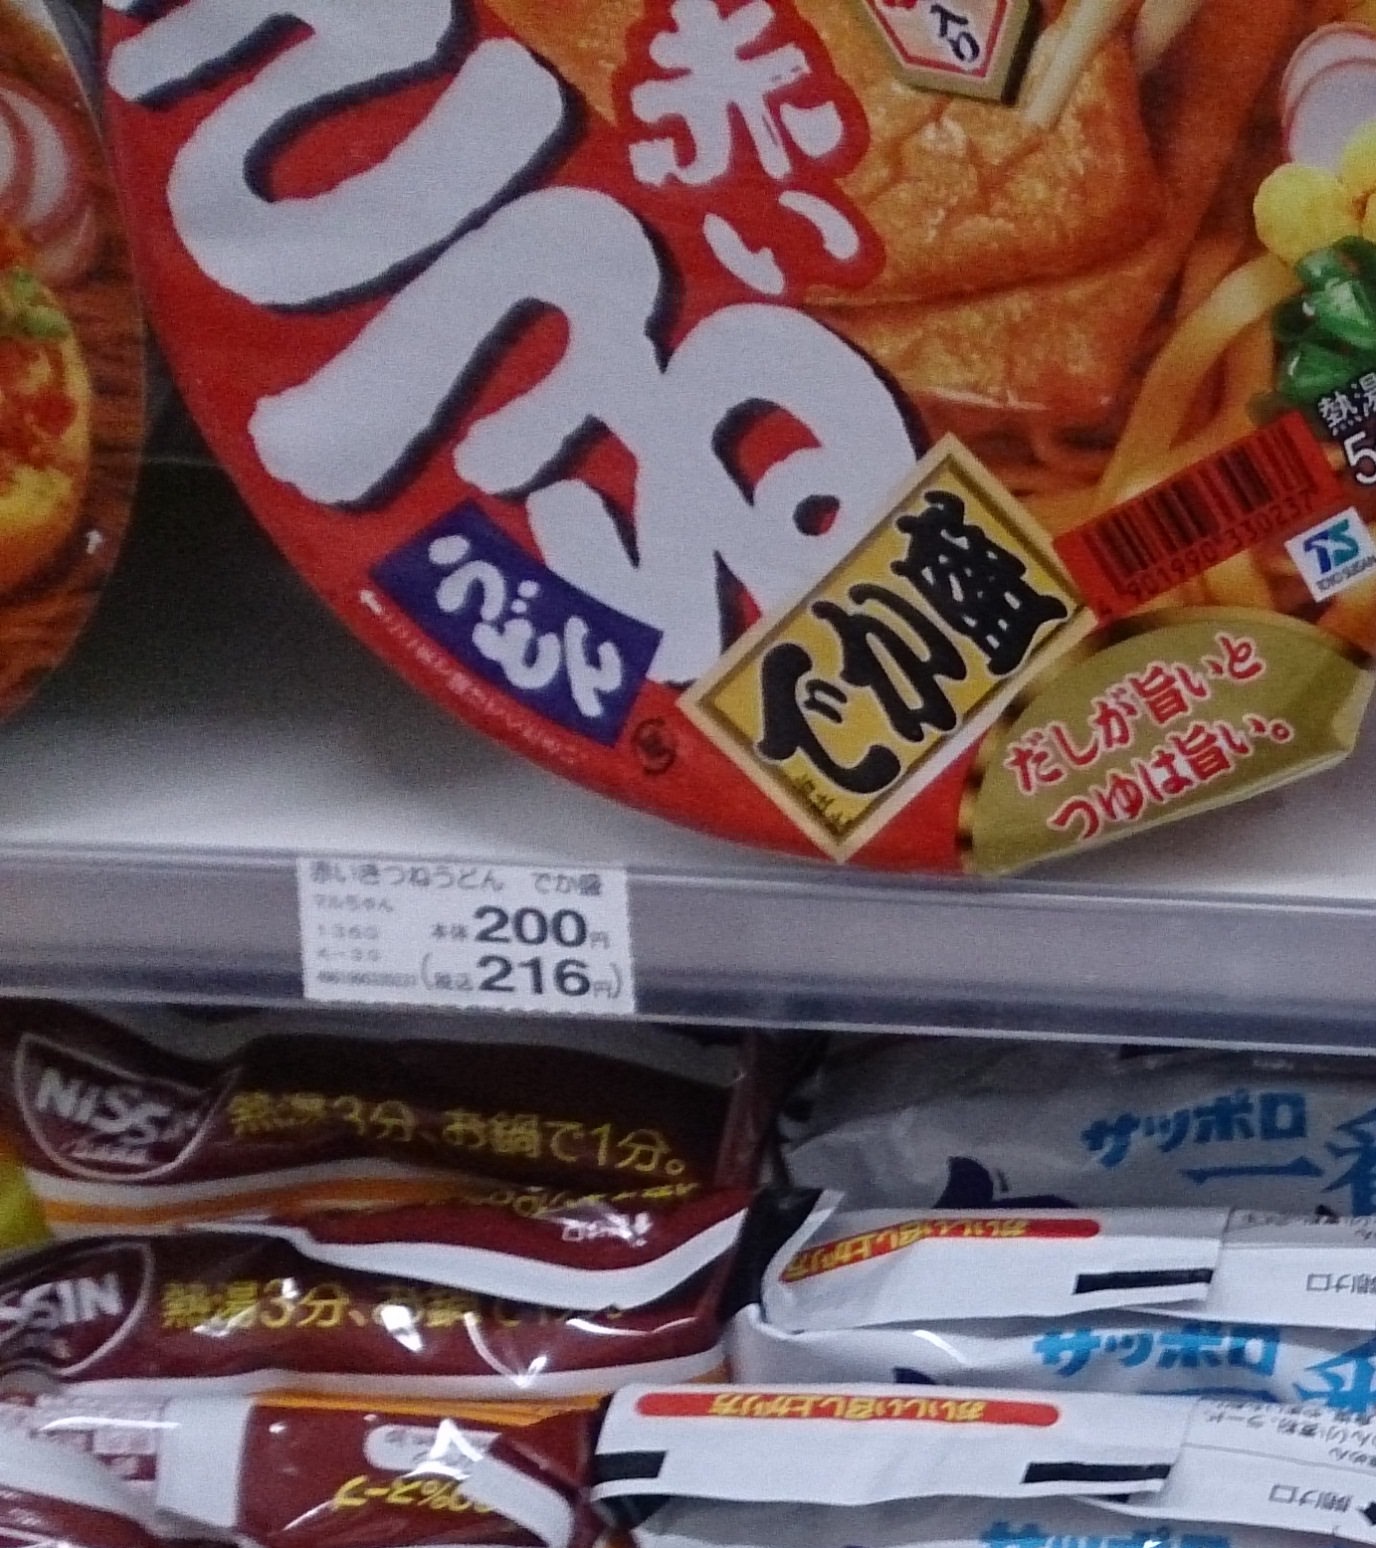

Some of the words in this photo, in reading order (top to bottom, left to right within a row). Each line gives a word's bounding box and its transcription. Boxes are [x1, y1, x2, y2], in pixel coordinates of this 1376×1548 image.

[630, 0, 860, 296] 赤い
[428, 533, 624, 719] うどん
[757, 490, 1068, 795] でか盛
[1008, 633, 1265, 793] だしが旨いと
[1050, 716, 1292, 839] つゆは旨い。
